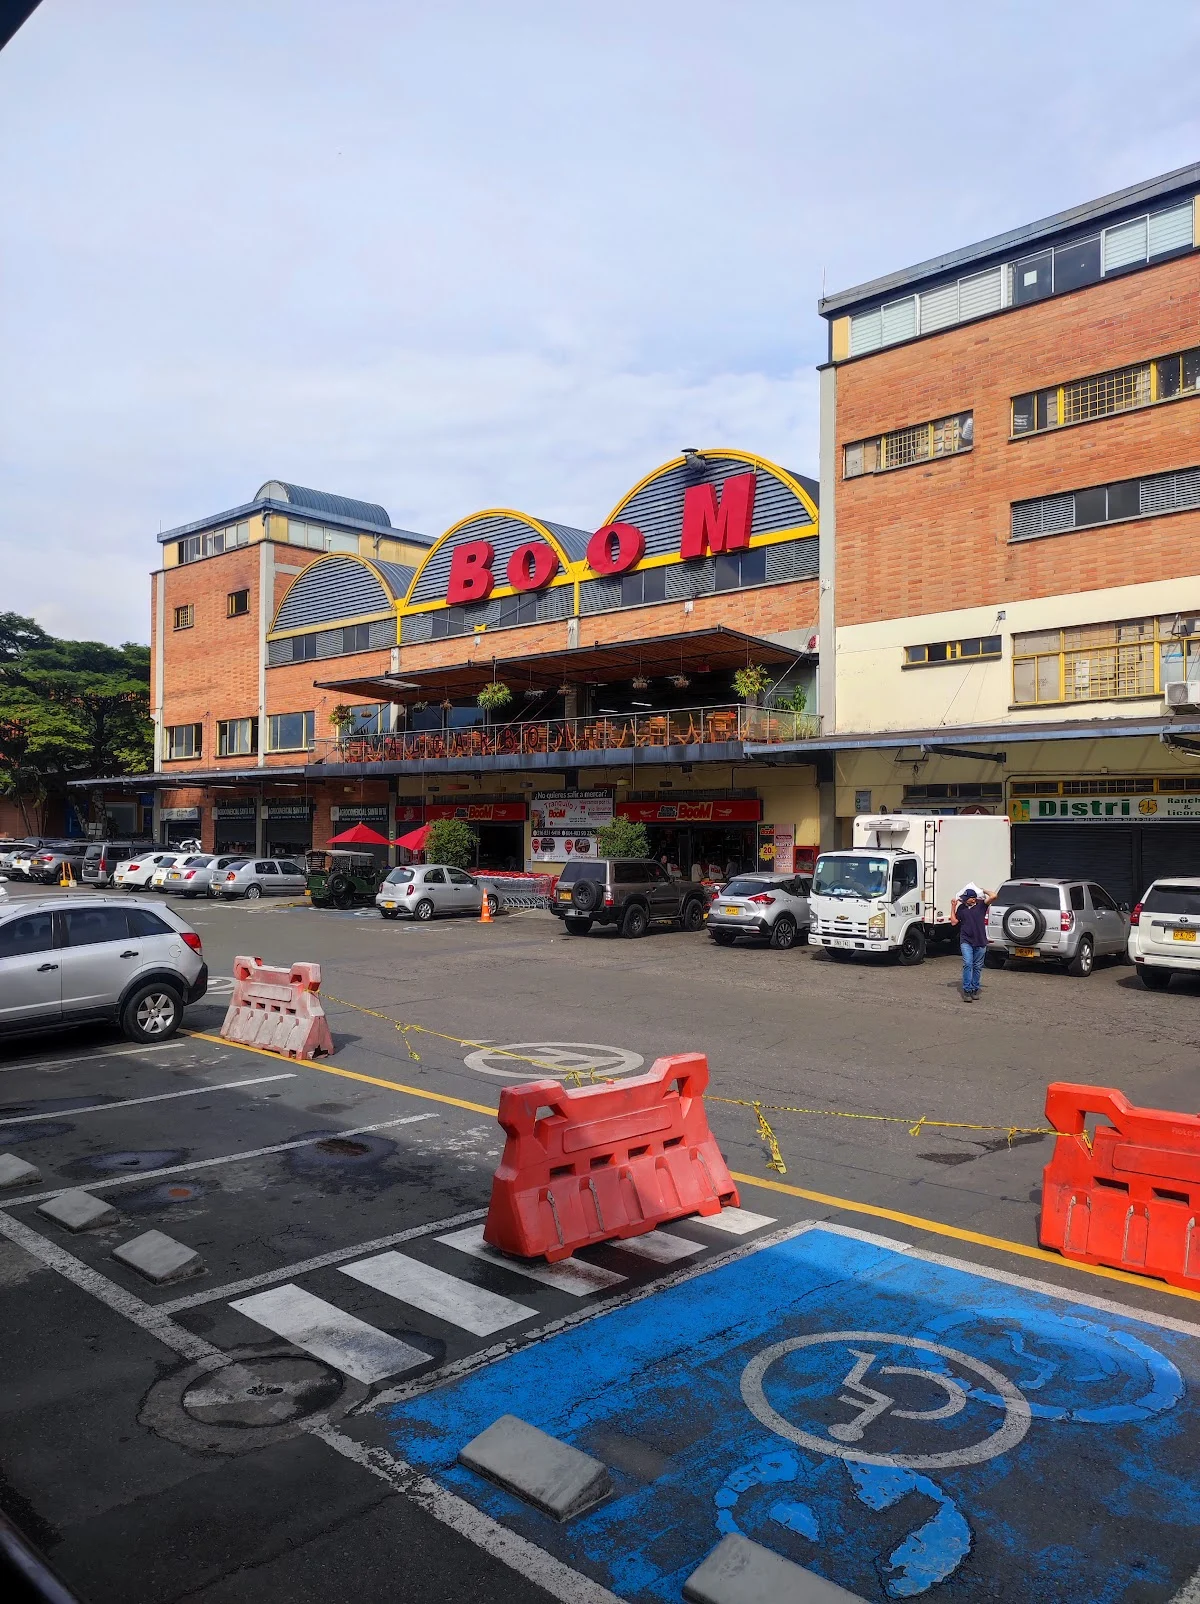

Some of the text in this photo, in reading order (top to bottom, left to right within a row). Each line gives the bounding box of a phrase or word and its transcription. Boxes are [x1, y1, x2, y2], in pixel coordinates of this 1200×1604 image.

[547, 791, 566, 800] quieres
[567, 790, 579, 798] salir
[584, 790, 608, 798] mercar?
[1039, 800, 1131, 816] Distri
